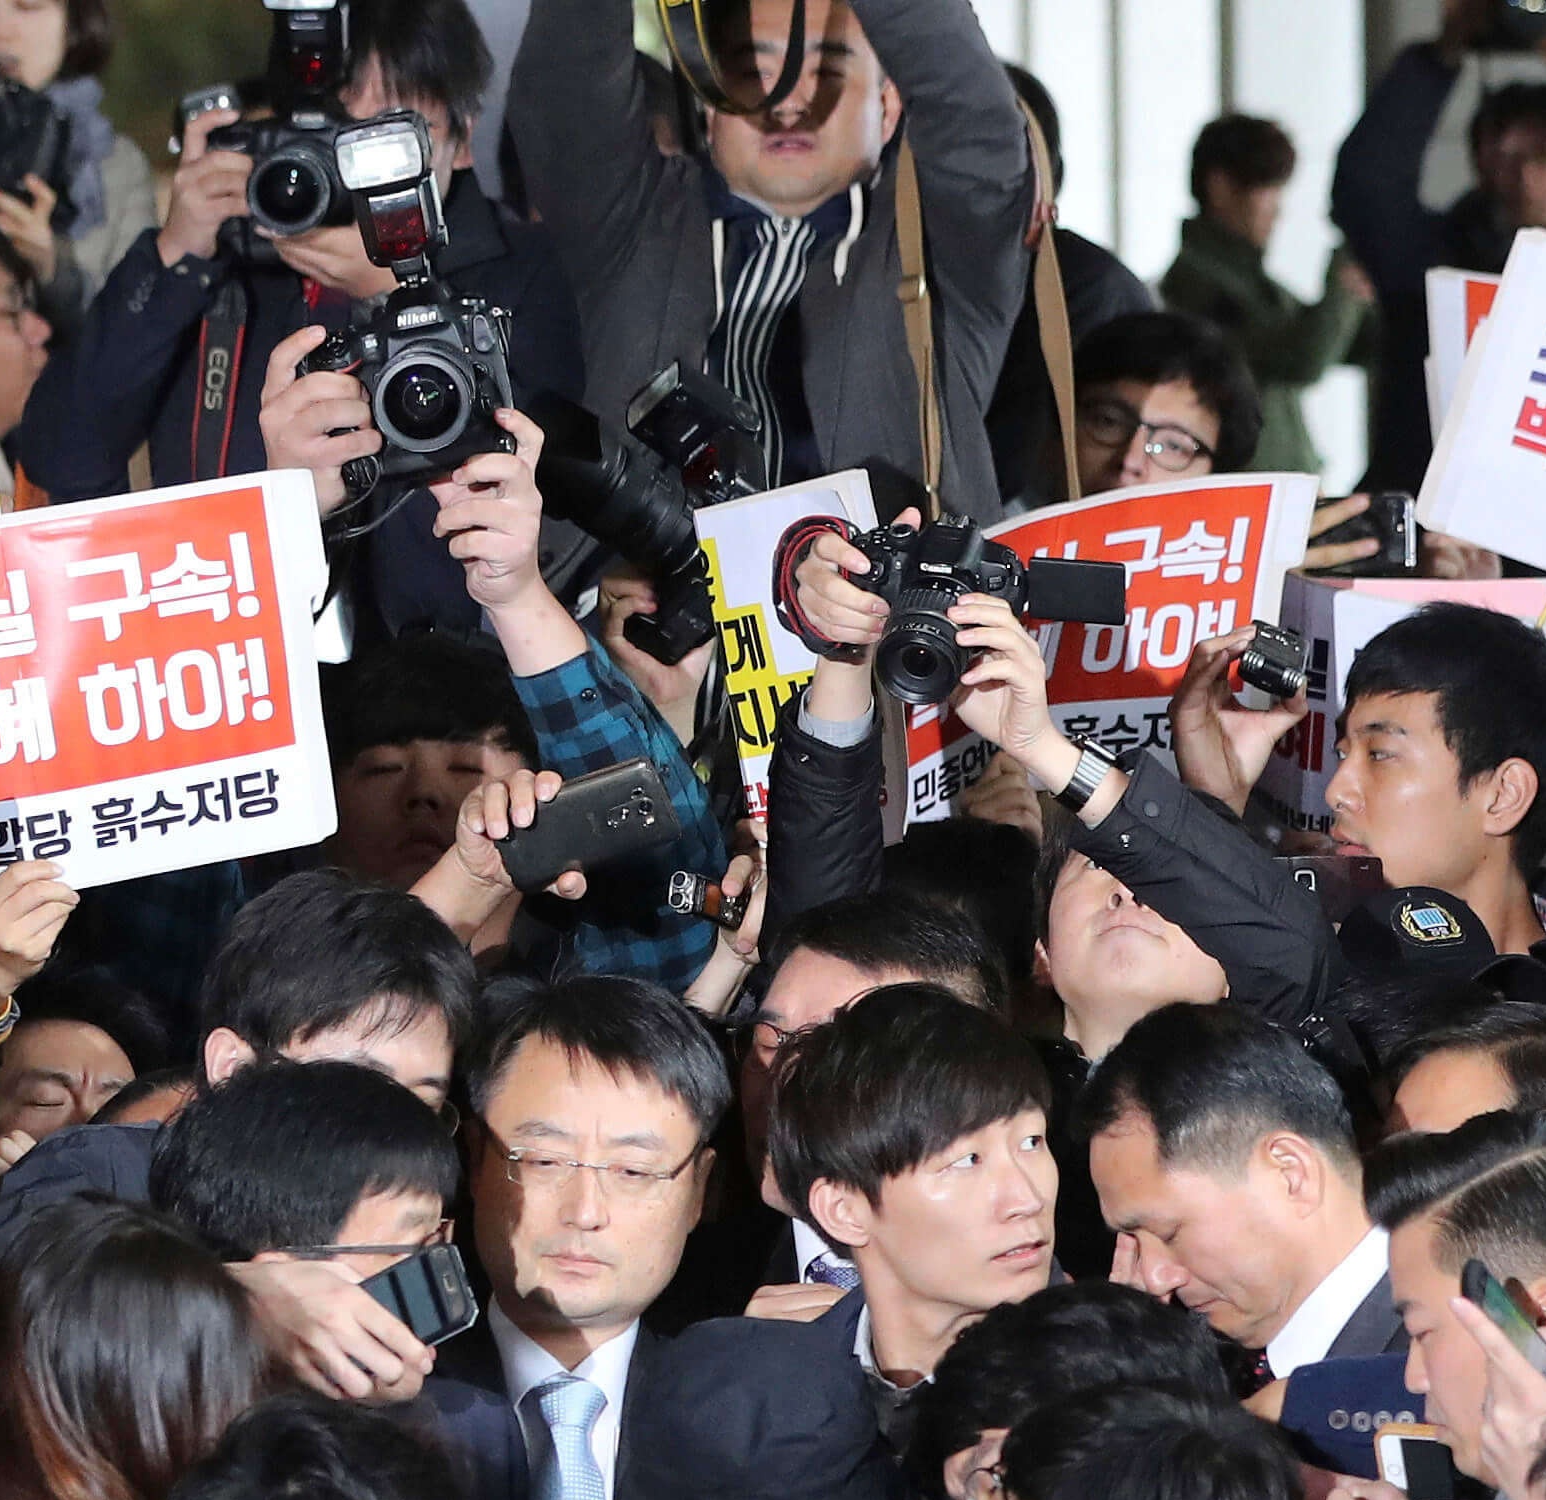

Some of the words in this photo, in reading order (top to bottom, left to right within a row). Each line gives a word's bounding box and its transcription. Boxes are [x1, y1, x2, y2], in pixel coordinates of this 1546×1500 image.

[396, 310, 438, 328] Nikon
[204, 346, 229, 411] EOS
[65, 530, 261, 643] 구속!
[1105, 516, 1252, 590] 구속!
[78, 636, 275, 747] 하야!
[91, 767, 281, 848] 흙수저당
[913, 739, 1001, 818] 민중연
